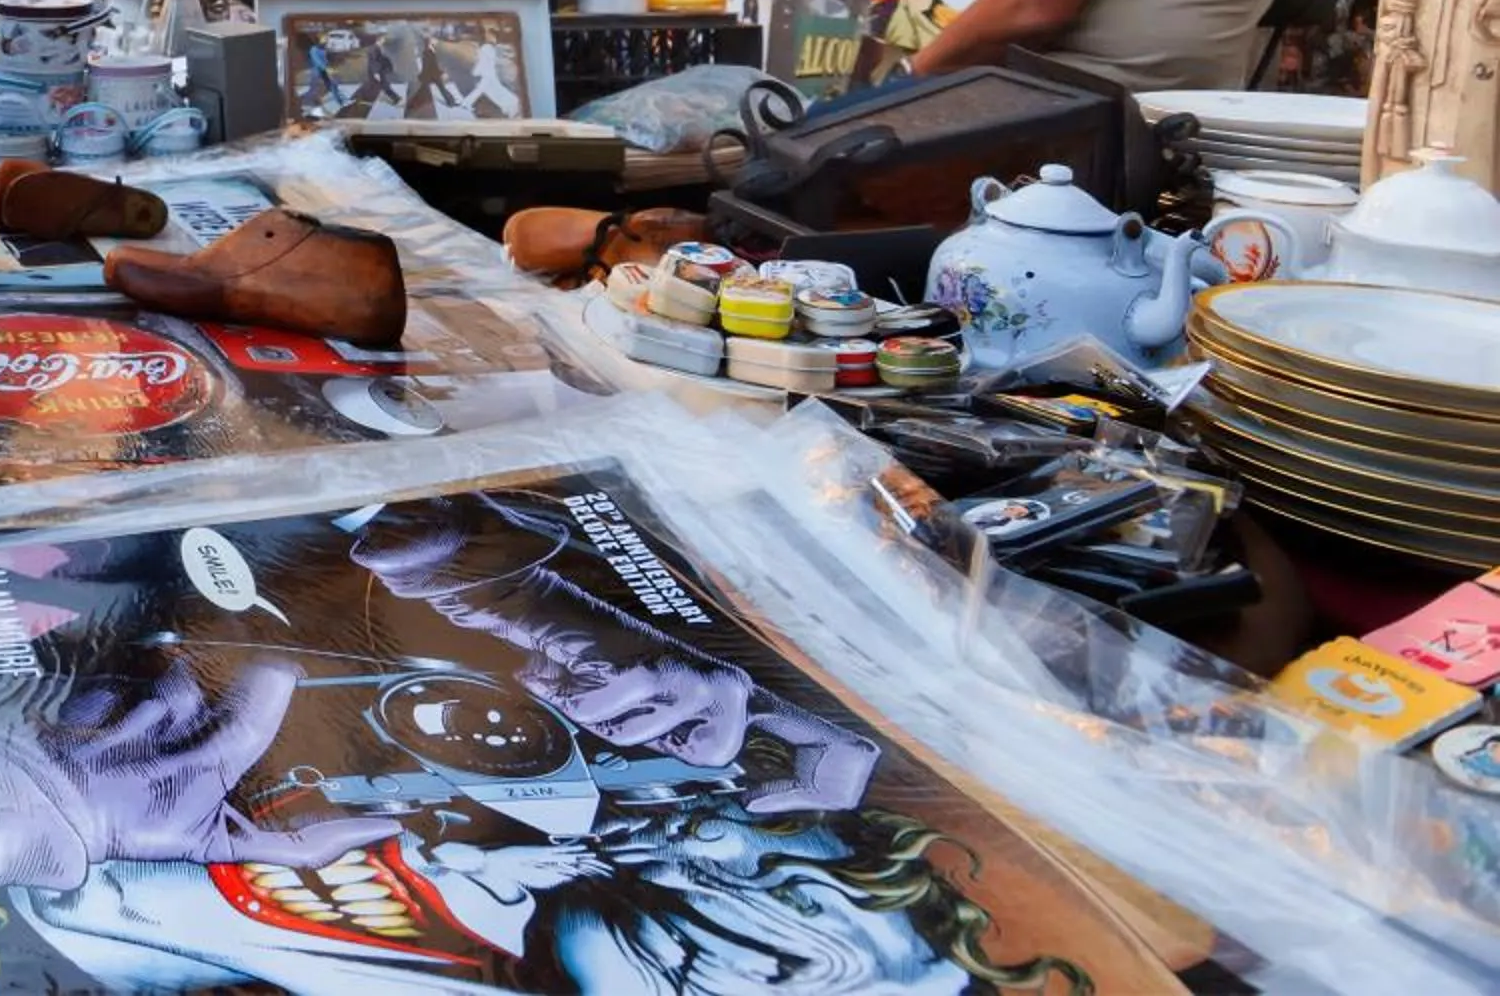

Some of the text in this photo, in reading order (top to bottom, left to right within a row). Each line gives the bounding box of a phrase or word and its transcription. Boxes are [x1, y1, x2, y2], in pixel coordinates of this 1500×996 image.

[795, 34, 860, 77] ALCO
[197, 543, 241, 595] SMILE!
[562, 494, 675, 617] DELUXE EDITION
[608, 523, 712, 626] ANNIVERSARY
